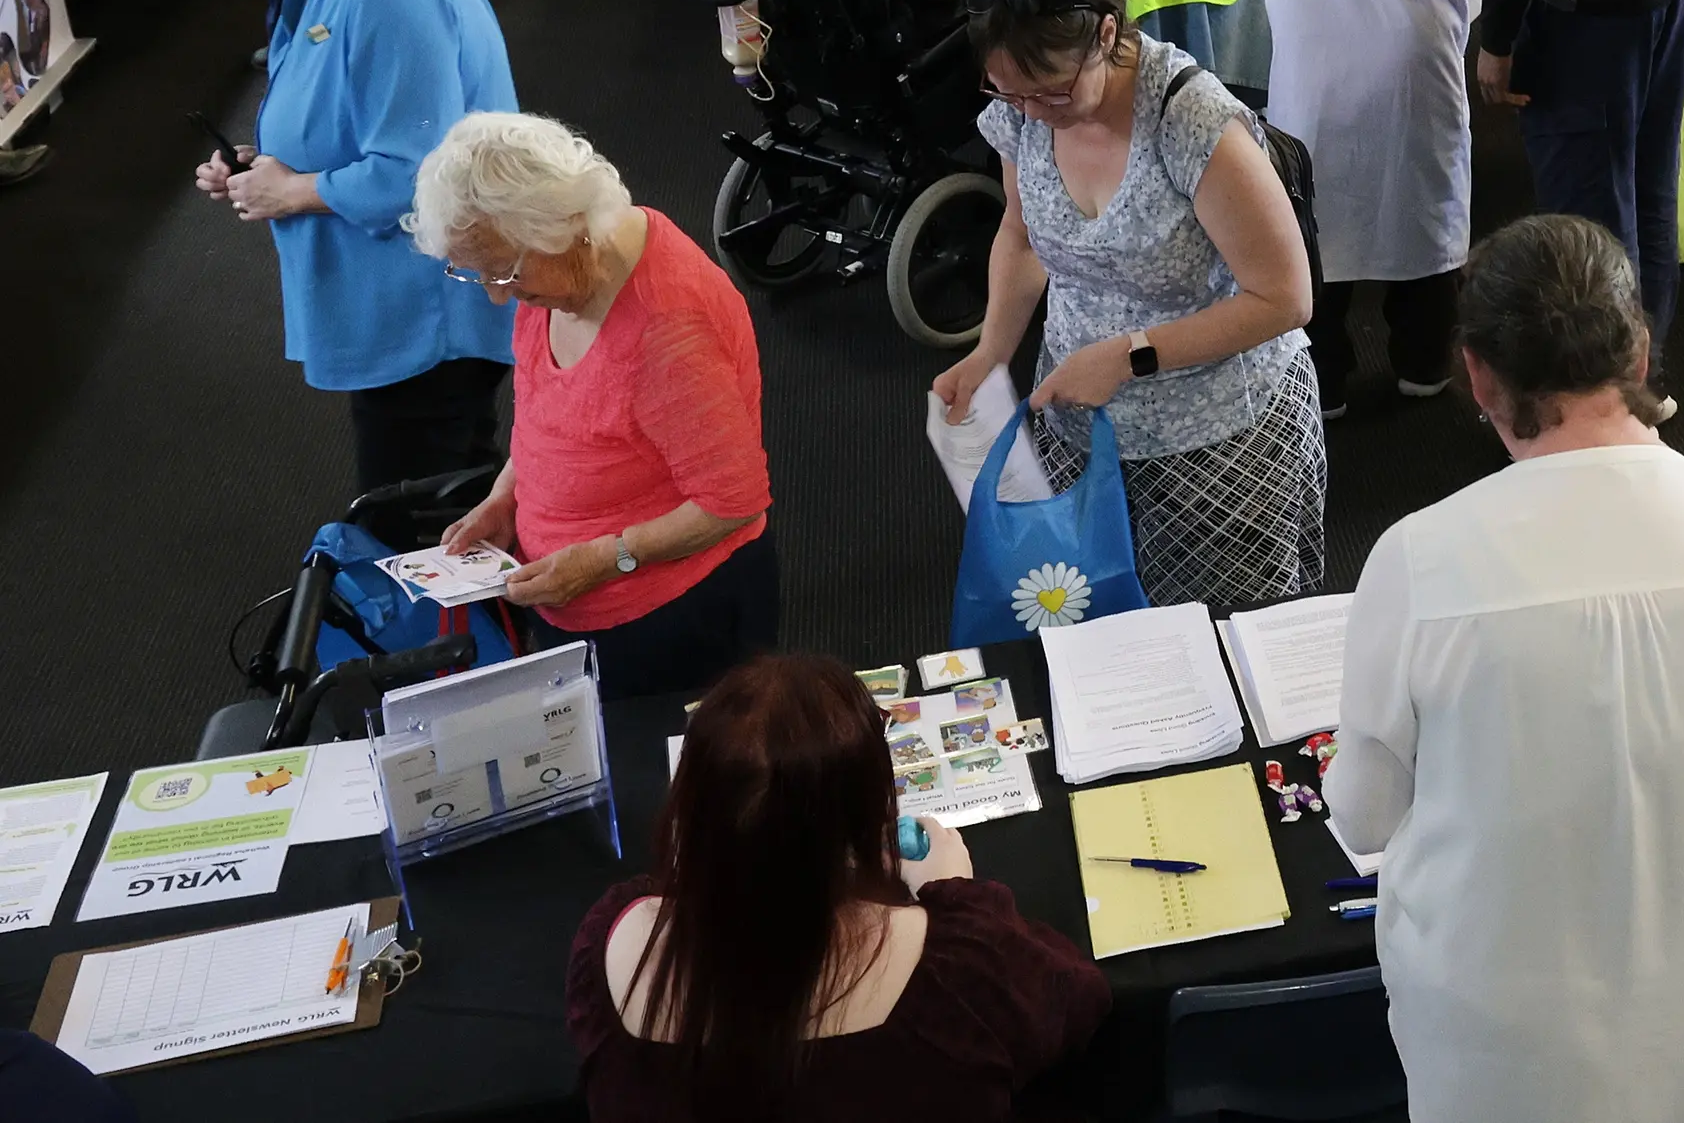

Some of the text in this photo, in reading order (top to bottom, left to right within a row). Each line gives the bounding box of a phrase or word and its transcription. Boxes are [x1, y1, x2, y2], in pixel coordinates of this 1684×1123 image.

[962, 795, 999, 807] Good
[1002, 789, 1021, 801] My
[127, 866, 242, 897] WRLG
[153, 1009, 341, 1051] WRLG Newsletter Signup
